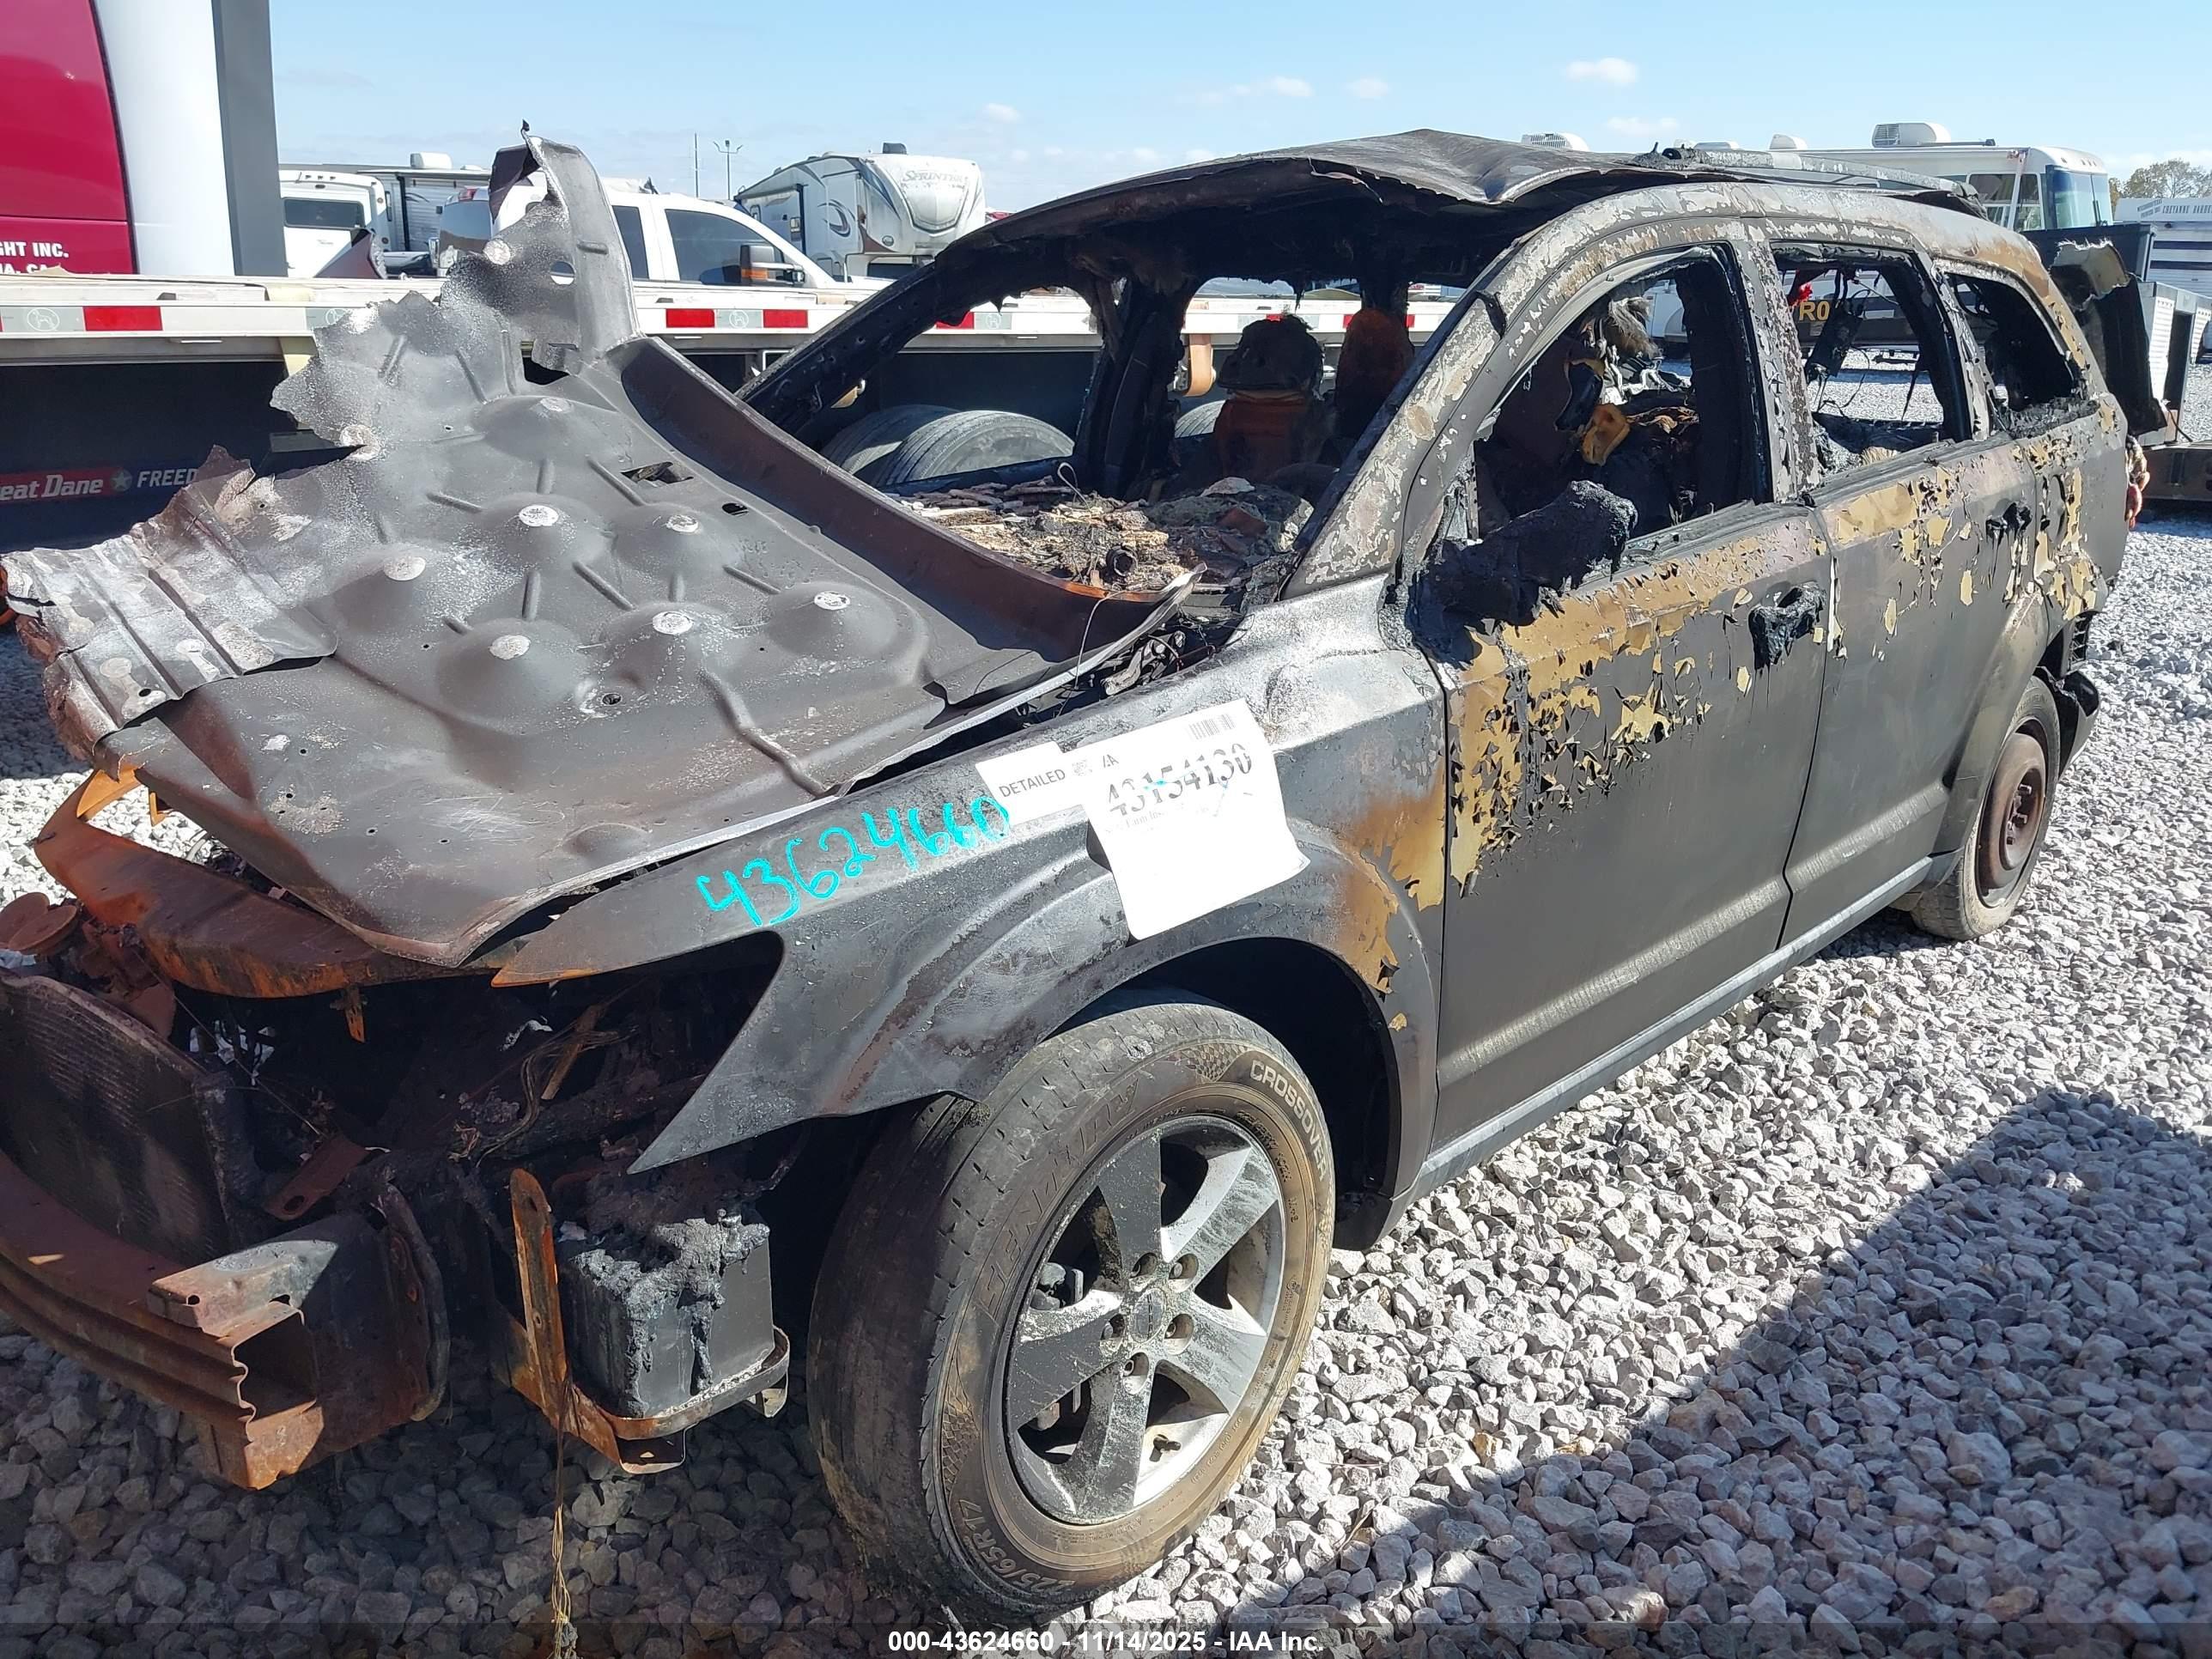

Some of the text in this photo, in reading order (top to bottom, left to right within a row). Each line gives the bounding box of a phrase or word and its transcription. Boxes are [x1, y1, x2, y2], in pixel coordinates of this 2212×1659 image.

[32, 242, 70, 258] INC.
[41, 474, 103, 497] Dane
[998, 768, 1067, 799] DETAILED
[1109, 743, 1253, 816] 43154130
[696, 794, 1012, 928] 43624660
[1249, 1059, 1328, 1182] CROSSOVER
[959, 1498, 1076, 1589] 225/65R17
